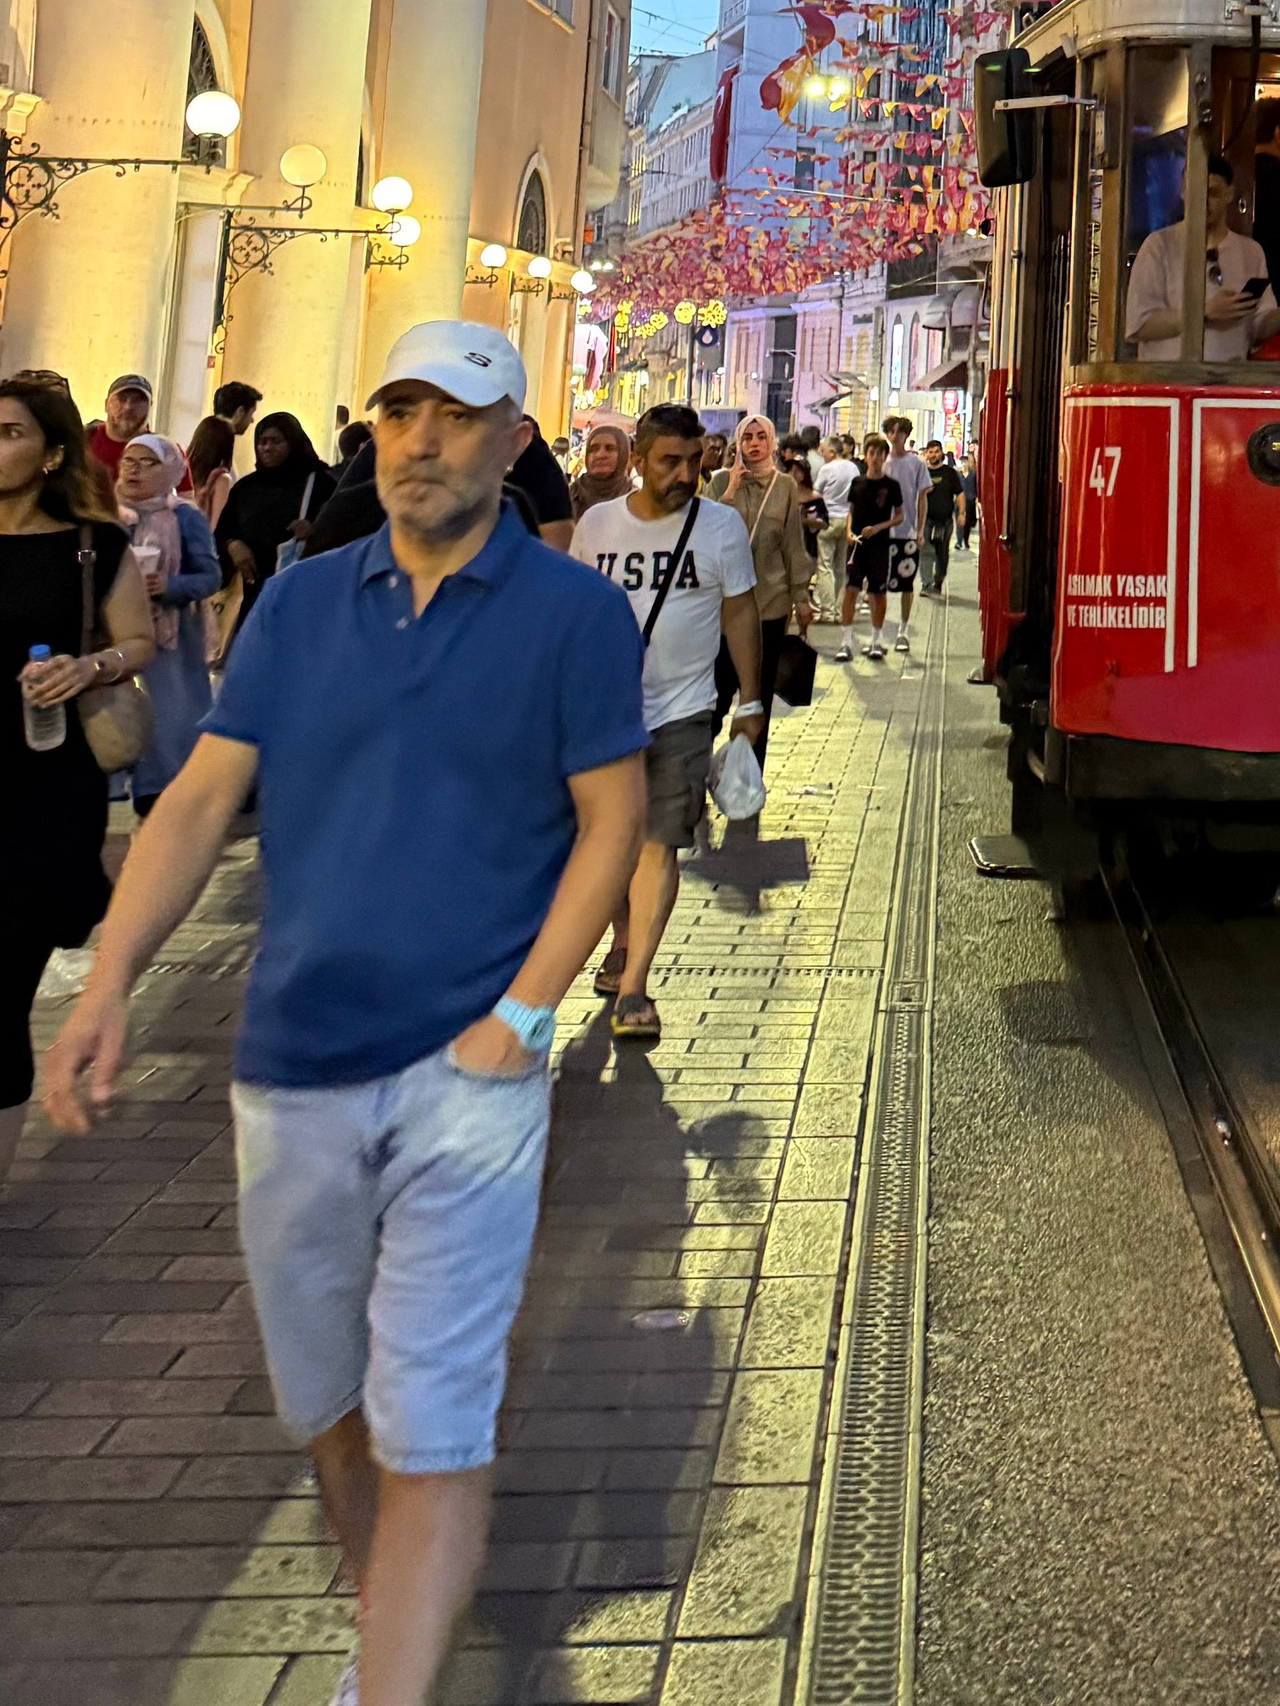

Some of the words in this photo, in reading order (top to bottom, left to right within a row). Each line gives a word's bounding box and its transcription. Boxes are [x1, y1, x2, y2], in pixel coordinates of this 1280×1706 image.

[1089, 446, 1122, 497] 47
[1067, 573, 1113, 597] ASILMAK
[1116, 574, 1168, 598] YASAK
[1067, 604, 1077, 628] VE
[1078, 601, 1167, 630] TEHLİKELİDİR
